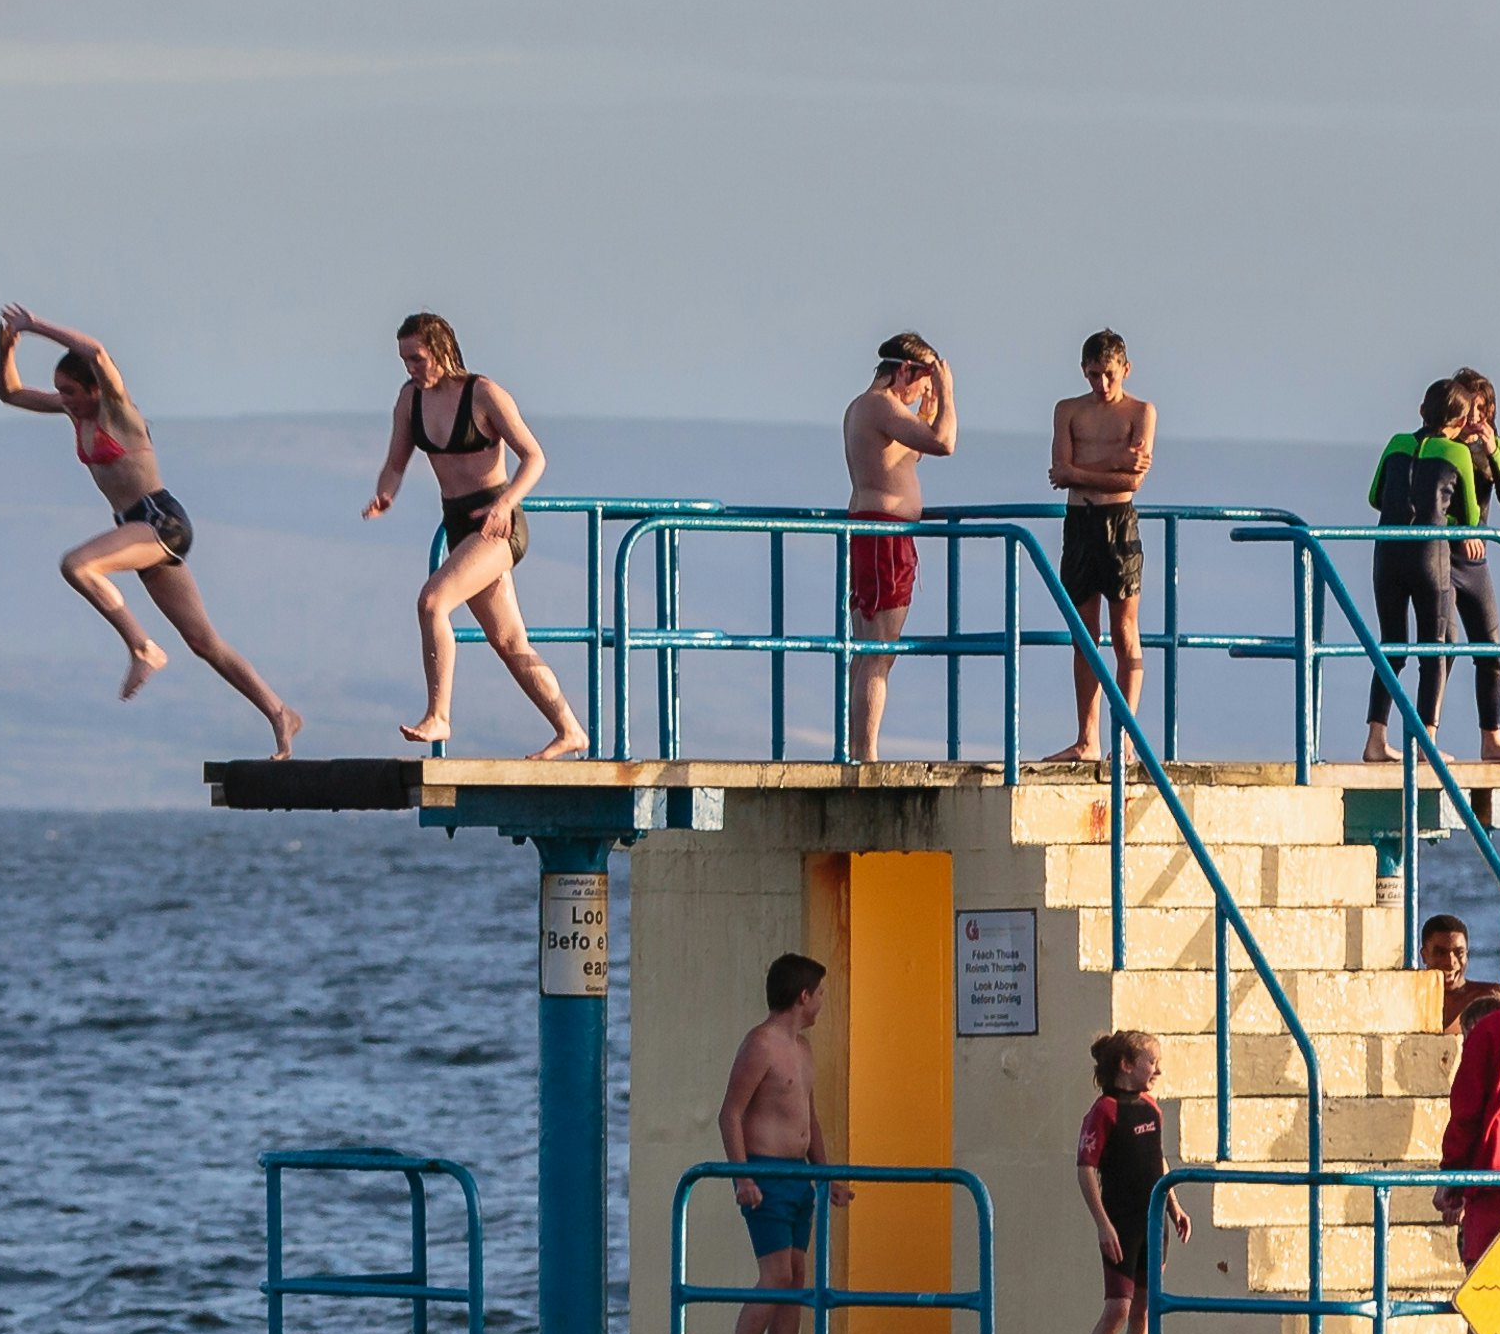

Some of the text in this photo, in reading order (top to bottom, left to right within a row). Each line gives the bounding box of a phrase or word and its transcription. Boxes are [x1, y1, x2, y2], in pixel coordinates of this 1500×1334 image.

[547, 930, 604, 950] Befoe
[974, 979, 1018, 991] Look Above
[971, 993, 1021, 1006] Before Diving
